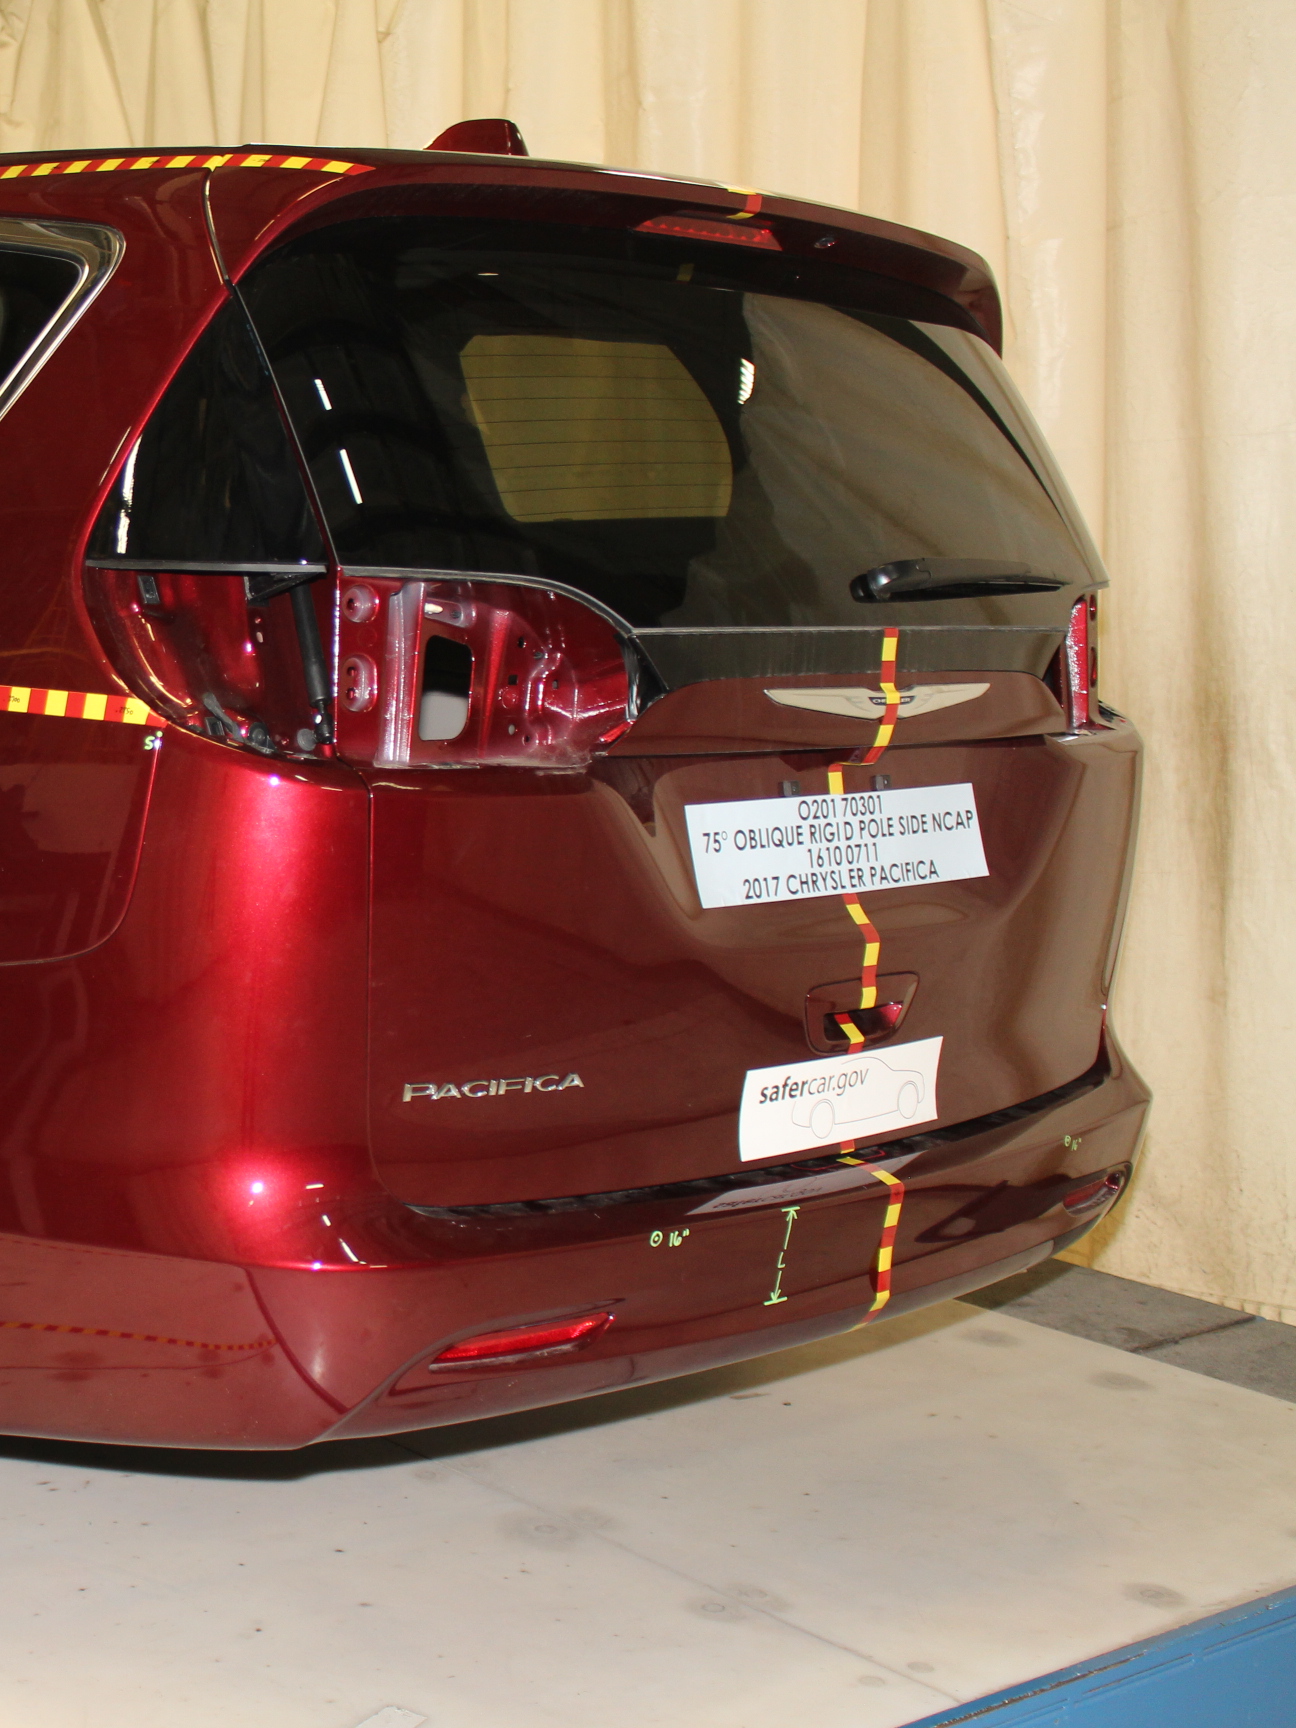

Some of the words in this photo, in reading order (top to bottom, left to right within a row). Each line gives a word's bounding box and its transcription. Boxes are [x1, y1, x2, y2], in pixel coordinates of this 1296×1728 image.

[733, 825, 805, 851] OBLIQUE
[809, 821, 854, 844] RIGID
[859, 817, 895, 840] POLE
[899, 813, 929, 836] SIDE
[933, 809, 974, 832] NCAP
[743, 876, 781, 900] 2017
[786, 868, 867, 895] CHRYSLER
[870, 859, 940, 885] PACIFICA
[402, 1073, 585, 1102] PACIFICA
[759, 1068, 870, 1105] safercar.gov
